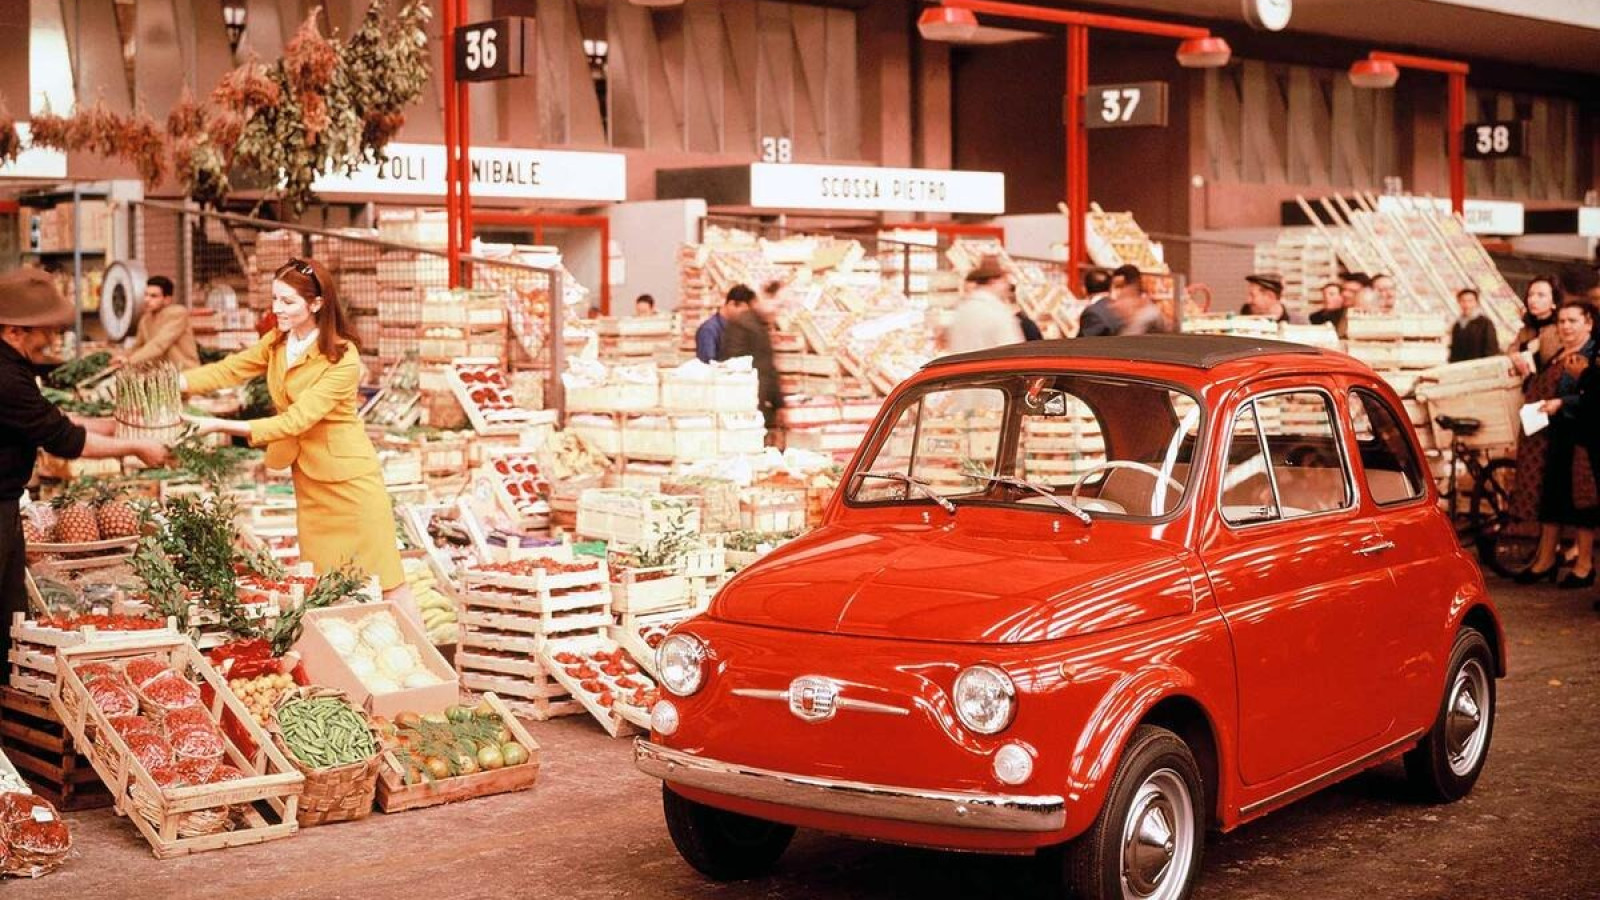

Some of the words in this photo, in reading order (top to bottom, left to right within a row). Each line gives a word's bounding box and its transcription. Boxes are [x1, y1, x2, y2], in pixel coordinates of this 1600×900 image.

[466, 28, 497, 71] 36
[1101, 88, 1140, 122] 37
[762, 136, 792, 163] 38
[1476, 125, 1509, 154] 38
[446, 159, 541, 185] NIBALE
[821, 177, 880, 198] SCOSSA
[893, 179, 946, 201] PIETRO
